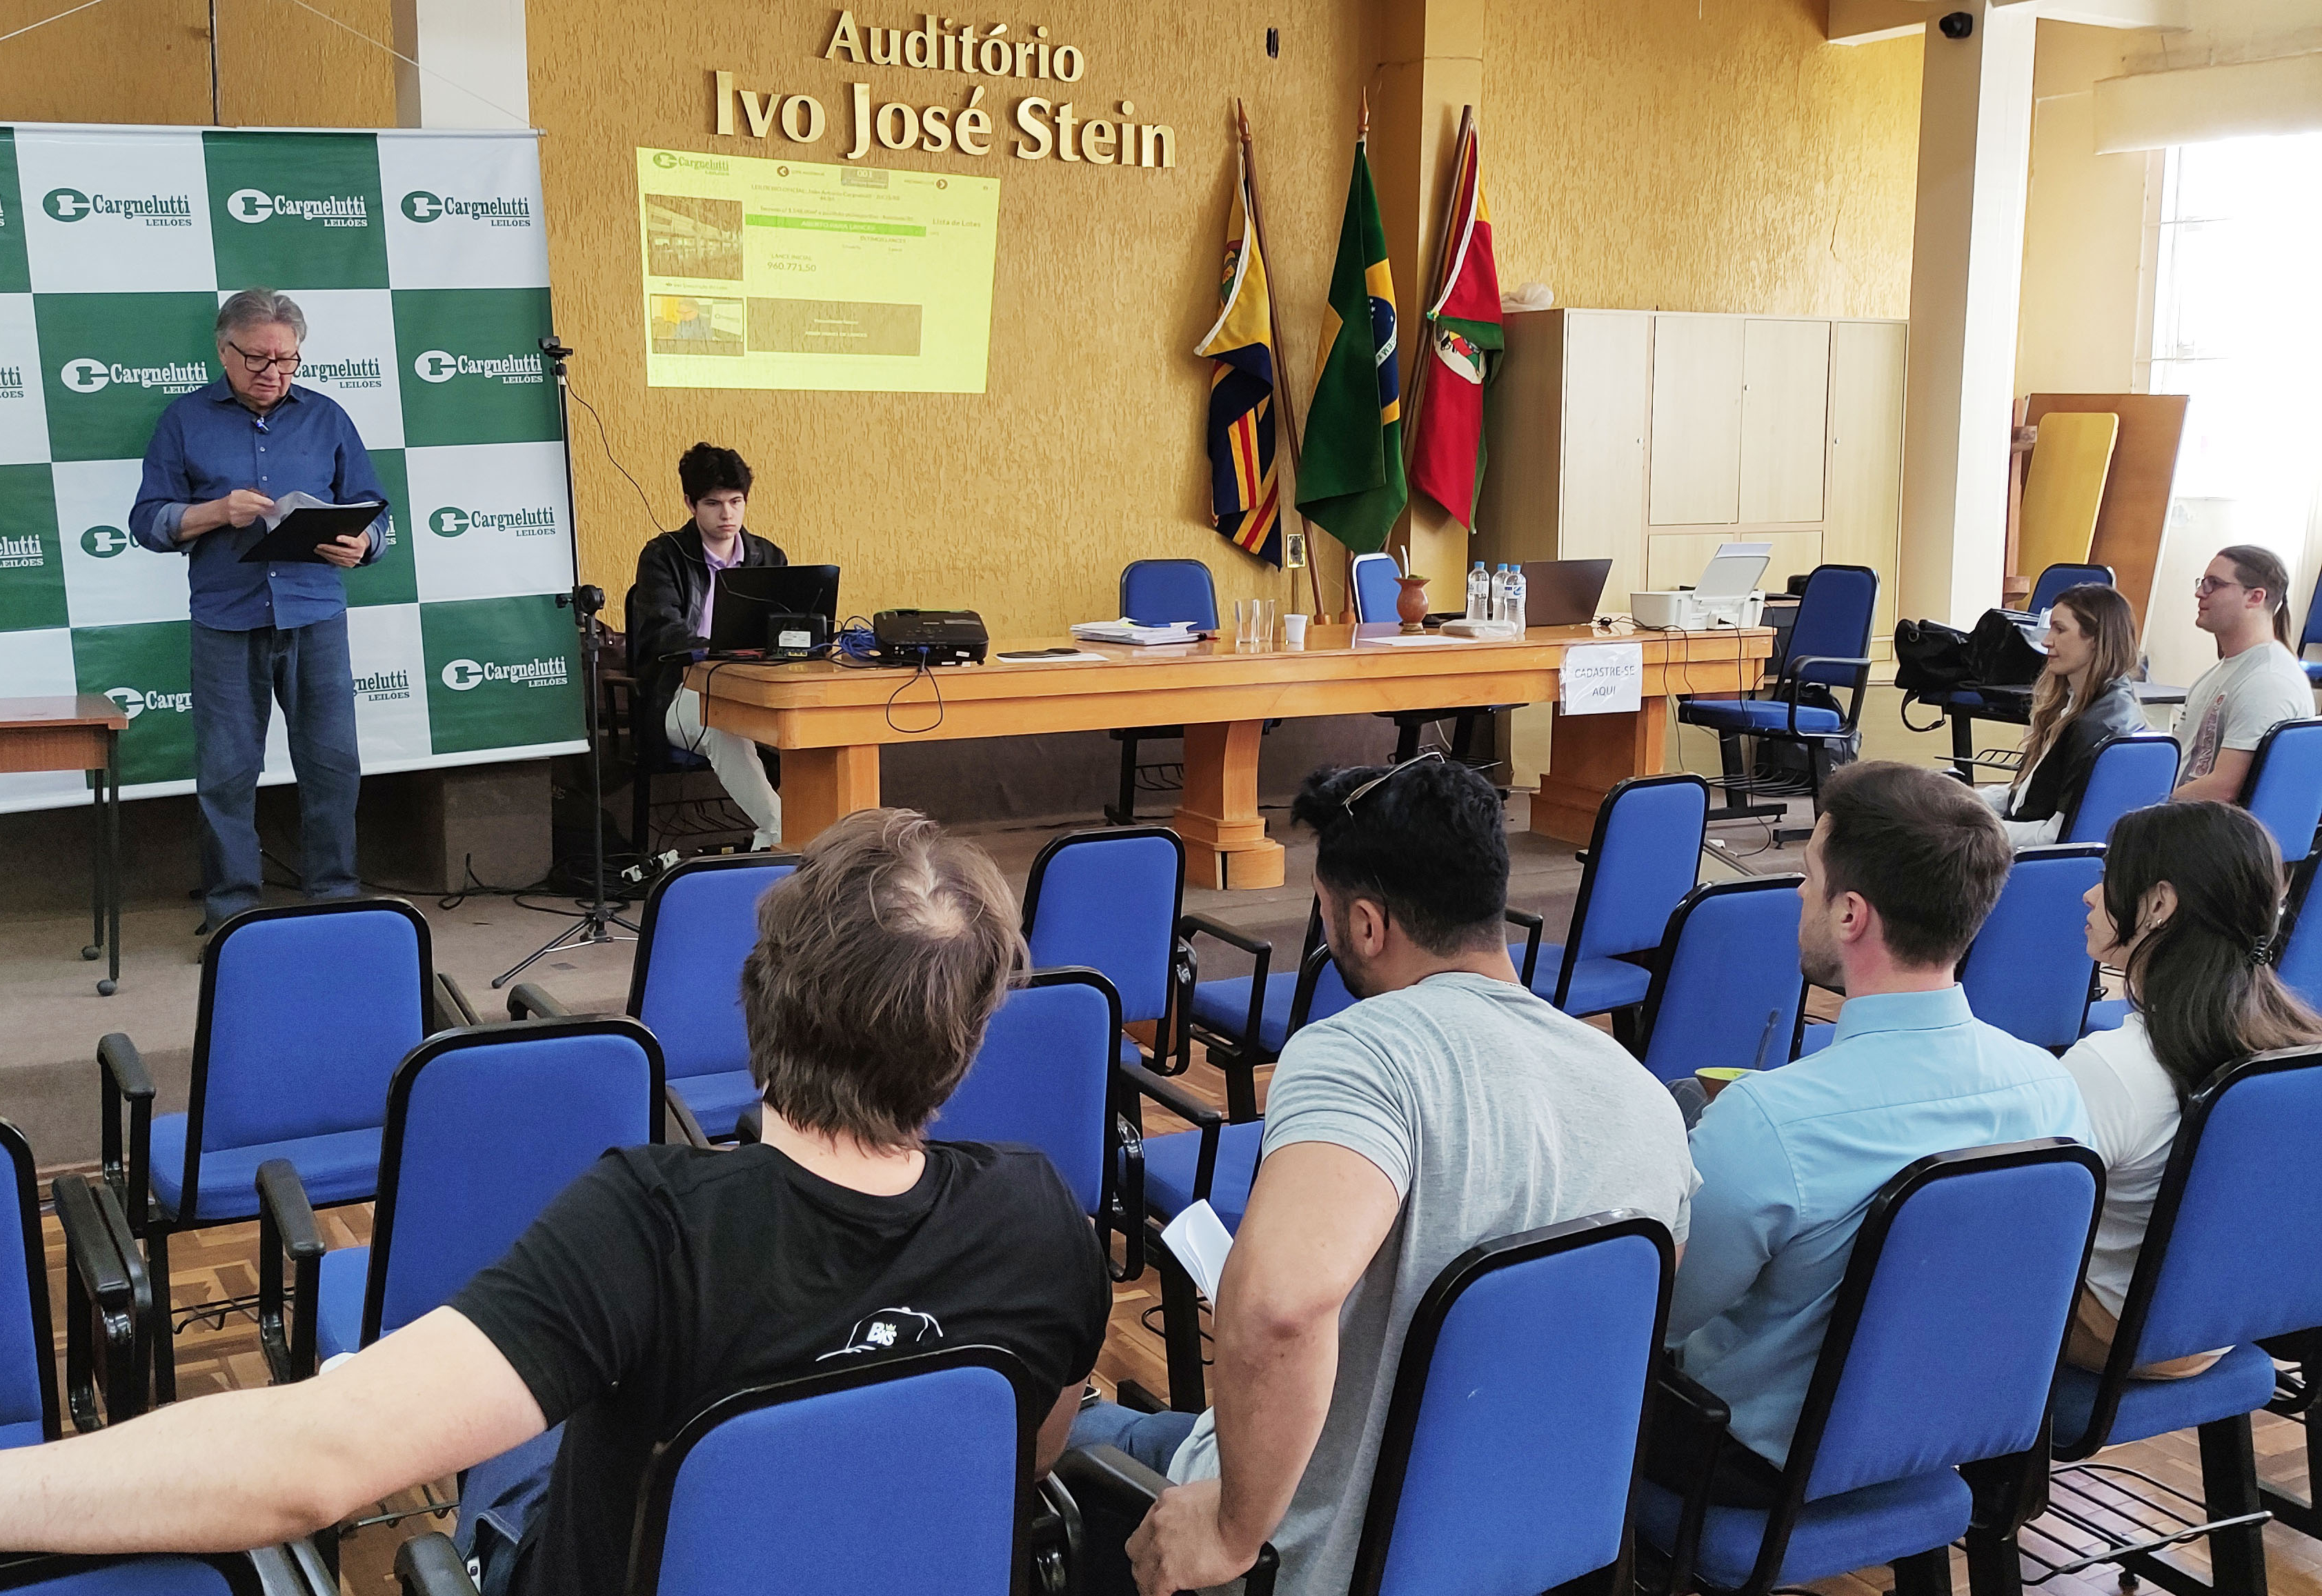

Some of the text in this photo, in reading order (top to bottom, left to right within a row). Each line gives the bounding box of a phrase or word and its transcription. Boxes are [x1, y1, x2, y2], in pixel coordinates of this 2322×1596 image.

[825, 10, 1084, 82] Auditório
[716, 70, 1176, 169] Ivo José Stein
[92, 194, 191, 219] Cargnelutti
[274, 195, 366, 220] Cargnelutti
[444, 197, 530, 220] Cargnelutti
[110, 361, 208, 388] Cargnelutti
[457, 353, 542, 378] Cargnelutti
[470, 506, 555, 532] Cargnelutti
[0, 558, 44, 568] EILÕES
[484, 656, 566, 683] Cargnelutti
[1574, 666, 1635, 679] CADASTRE-SE
[1592, 686, 1616, 697] AQUI
